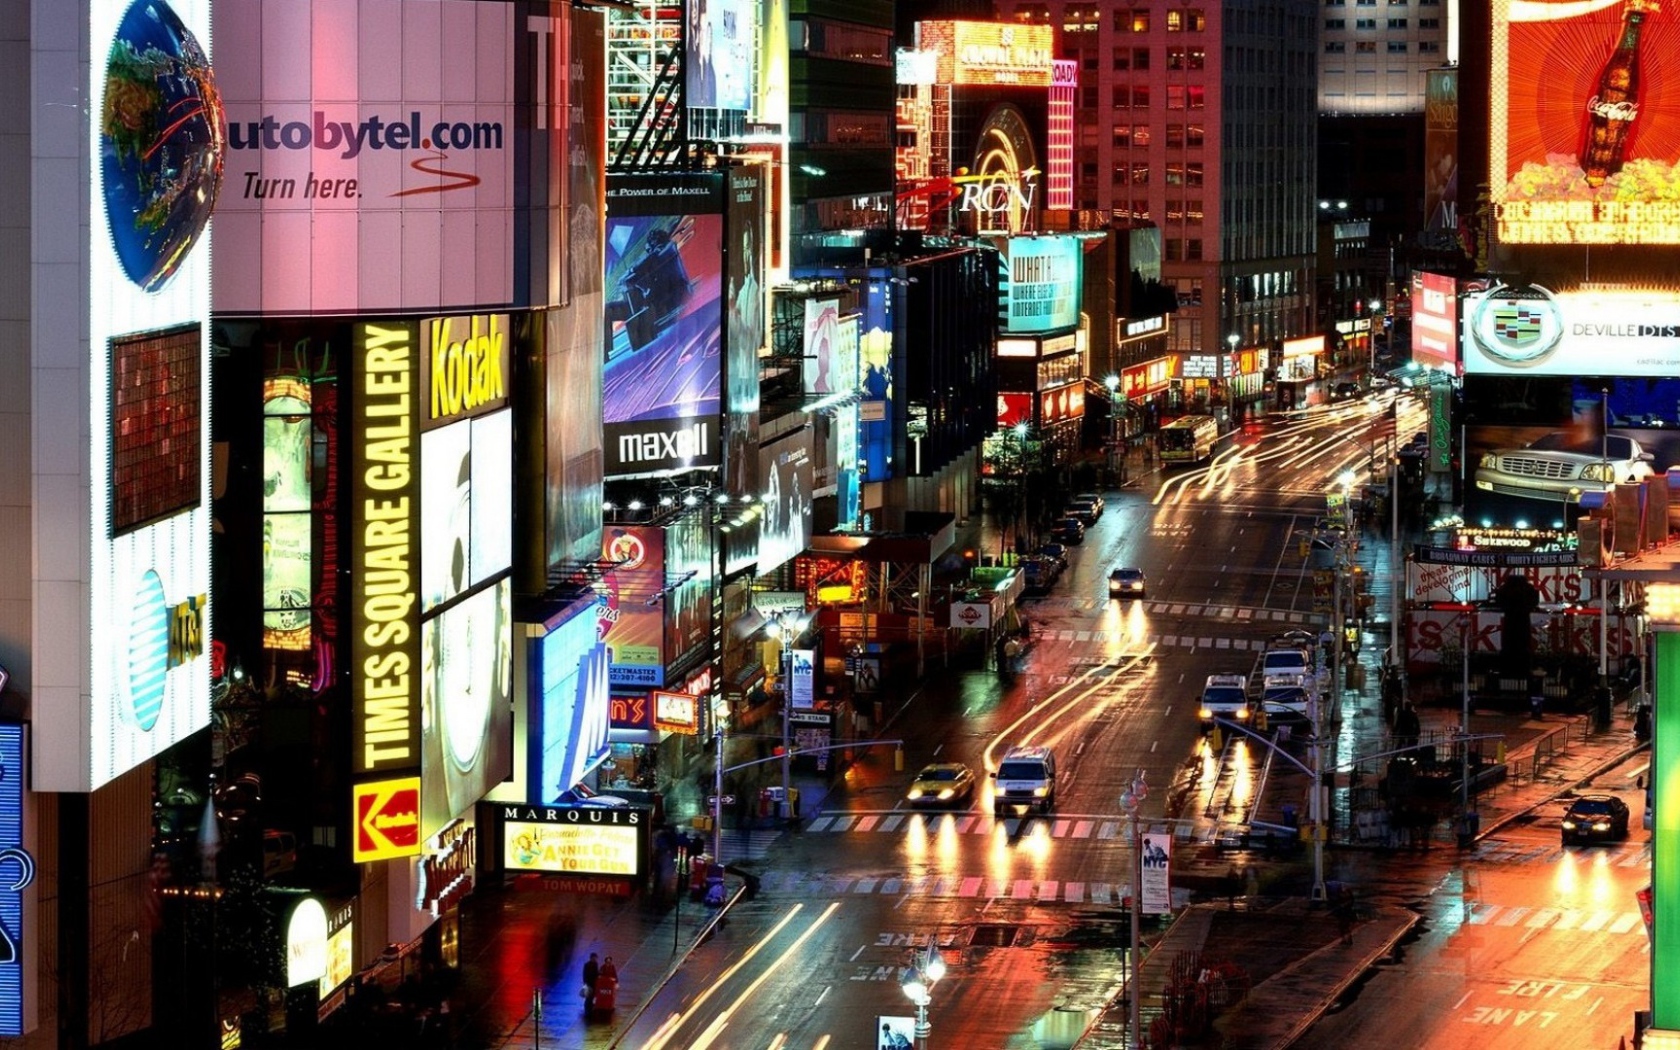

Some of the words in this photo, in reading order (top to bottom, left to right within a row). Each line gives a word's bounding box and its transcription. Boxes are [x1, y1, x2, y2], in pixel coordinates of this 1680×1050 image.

[243, 172, 297, 199] Turn
[304, 172, 363, 199] here.
[620, 188, 654, 196] POWER
[672, 186, 710, 195] MAXELL
[959, 183, 1036, 211] RCN
[1573, 323, 1636, 337] DEVILLE
[1642, 324, 1677, 338] DTS
[430, 314, 502, 419] Kodak
[364, 324, 410, 491] GALLERY
[619, 422, 708, 463] maxell
[364, 497, 415, 647] SQUARE
[794, 666, 811, 676] NYC
[364, 652, 410, 768] TIMES
[504, 807, 639, 824] MARQUIS
[543, 845, 589, 861] ANNIE
[1144, 854, 1167, 868] NYC
[543, 880, 573, 890] TOM
[576, 881, 621, 894] WOPAT
[1497, 979, 1593, 1000] FIRE
[1462, 1006, 1561, 1028] LANE
